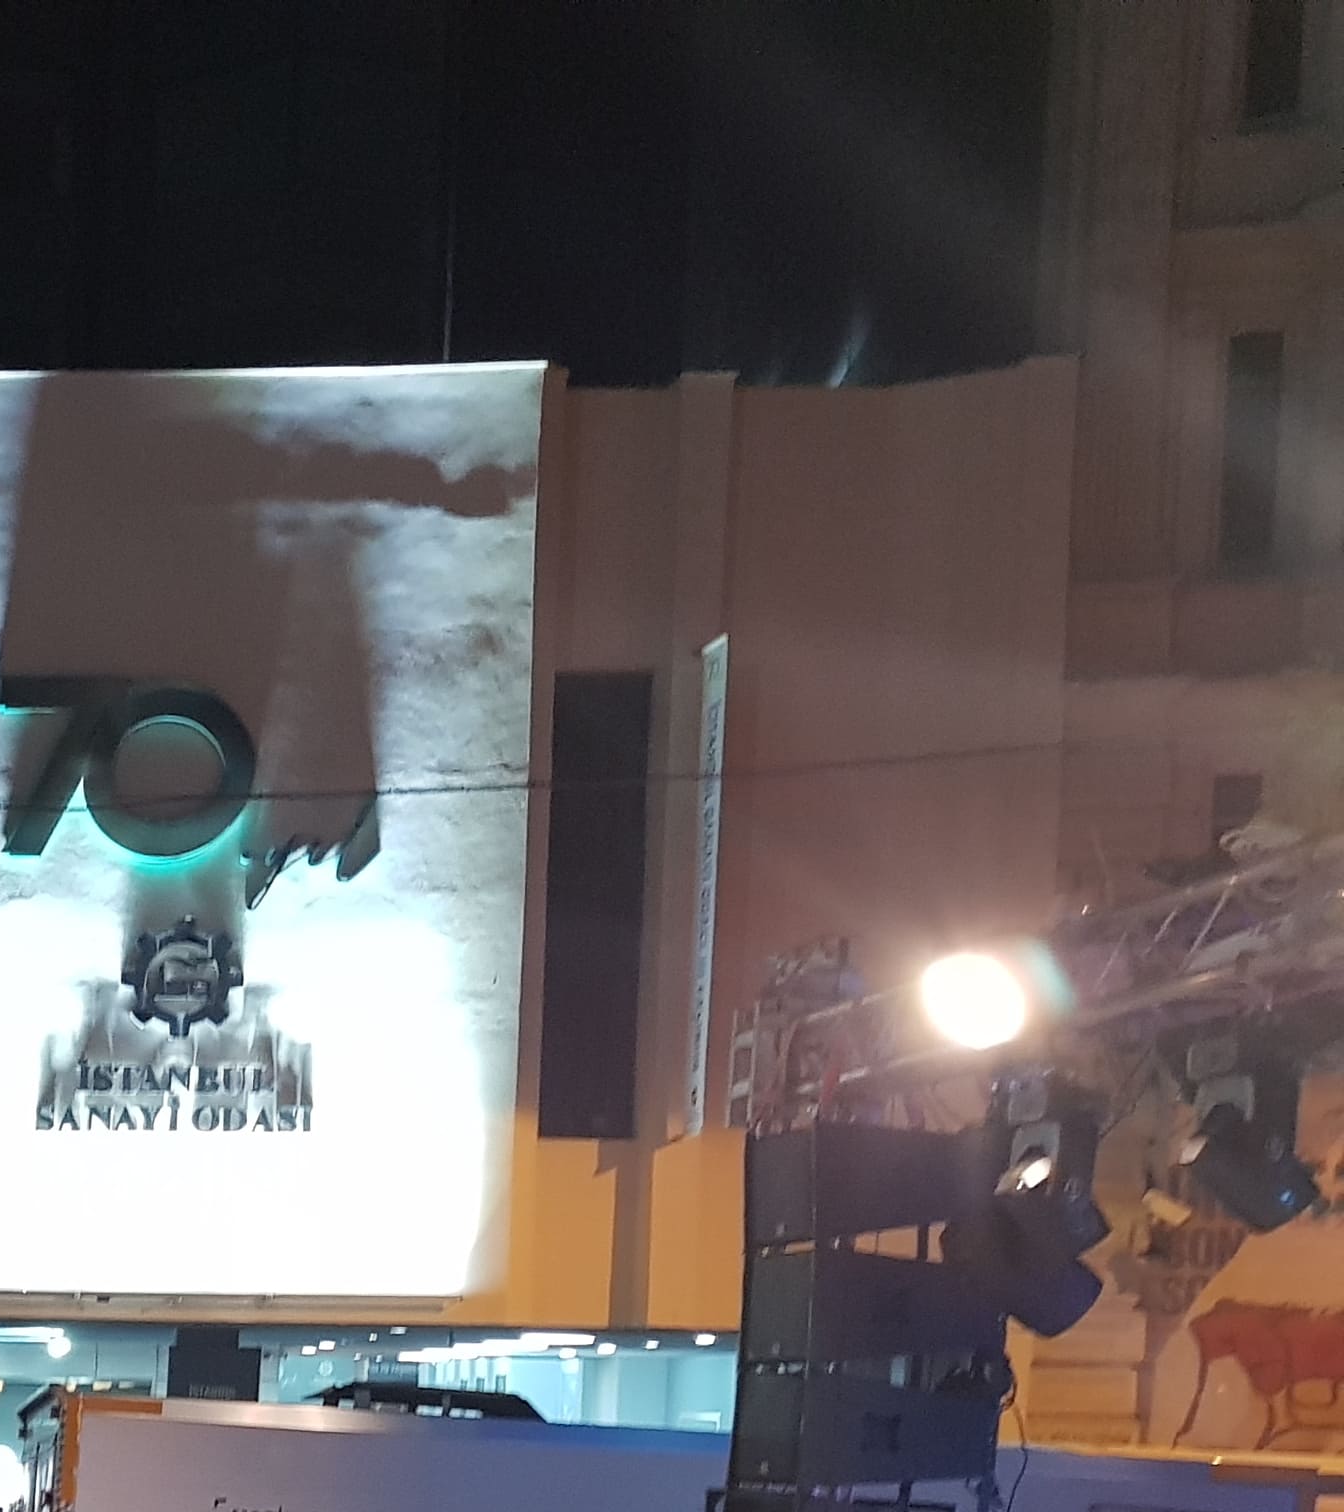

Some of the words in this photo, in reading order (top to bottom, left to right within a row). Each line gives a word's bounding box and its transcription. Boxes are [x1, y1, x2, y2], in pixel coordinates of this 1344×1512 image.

[77, 1057, 274, 1092] İSTANBUL
[35, 1095, 180, 1131] SANAYİ
[191, 1104, 312, 1132] ODASI
